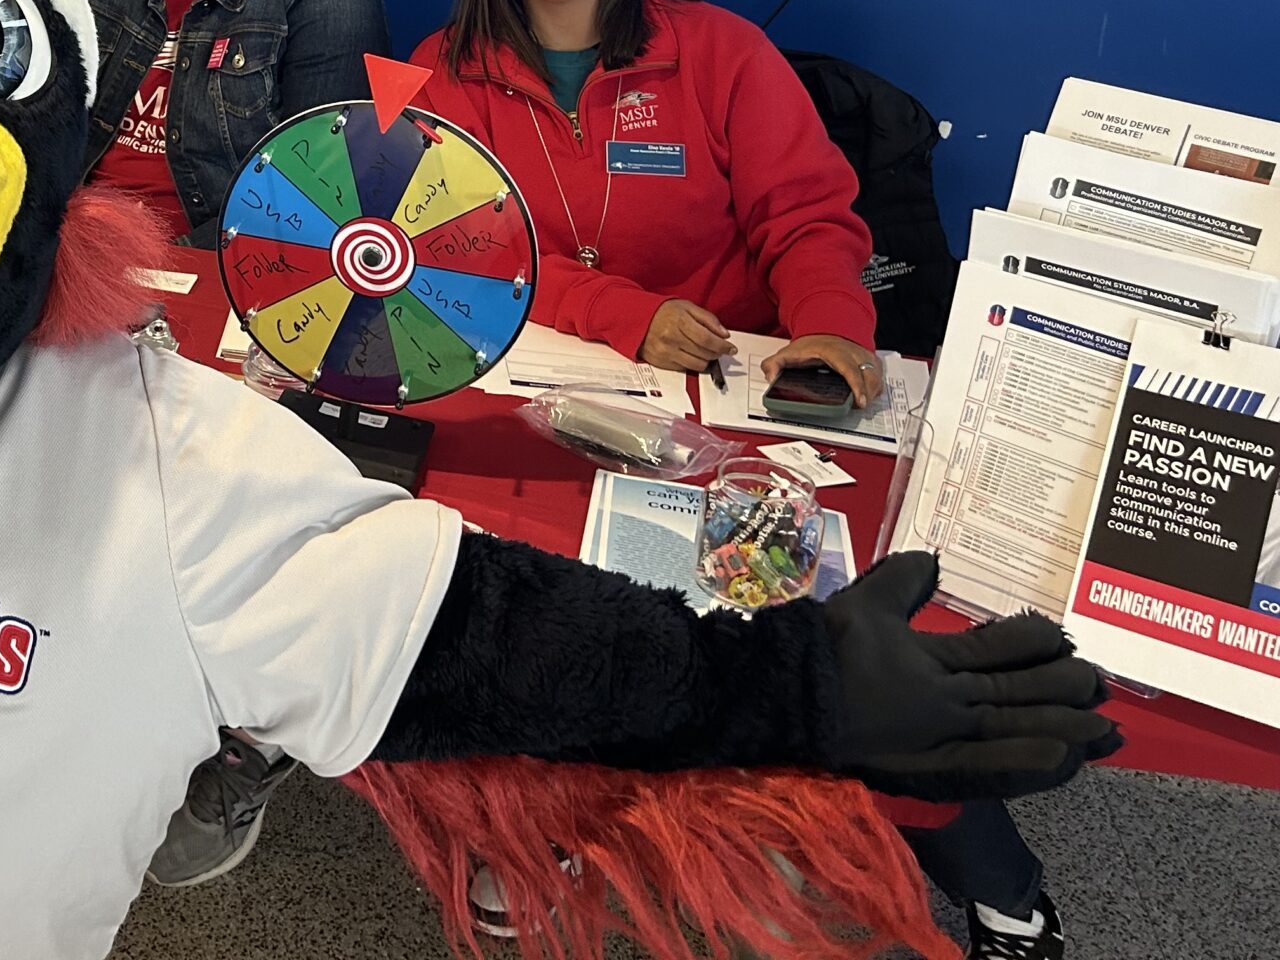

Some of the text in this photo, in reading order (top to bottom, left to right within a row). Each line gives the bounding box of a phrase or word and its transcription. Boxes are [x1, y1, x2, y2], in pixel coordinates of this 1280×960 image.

[620, 105, 654, 124] MSU
[622, 120, 658, 132] DENVER
[1082, 109, 1170, 136] JOIN MSU DENVER
[1101, 123, 1143, 139] DEBATE!
[1194, 134, 1275, 157] CIVIC DEBATE PROGRAM
[1090, 186, 1245, 234] COMMUNICATION STUDIES MAJOR, B.A.
[1041, 263, 1200, 310] COMMUNICATION STUDIES MAJOR, B.A.
[1027, 314, 1128, 350] COMMUNICATION STUDIES
[1132, 413, 1275, 458] CAREER LAUNCHPAD
[1123, 448, 1231, 492] PASSION
[1127, 429, 1276, 482] FIND A NEW
[1115, 481, 1209, 515] improve your
[1118, 470, 1216, 505] Learn tools to
[1107, 519, 1157, 541] course.
[1110, 506, 1238, 551] skills in this online
[1112, 495, 1221, 533] communication
[1088, 579, 1215, 640] CHANGEMAKERS
